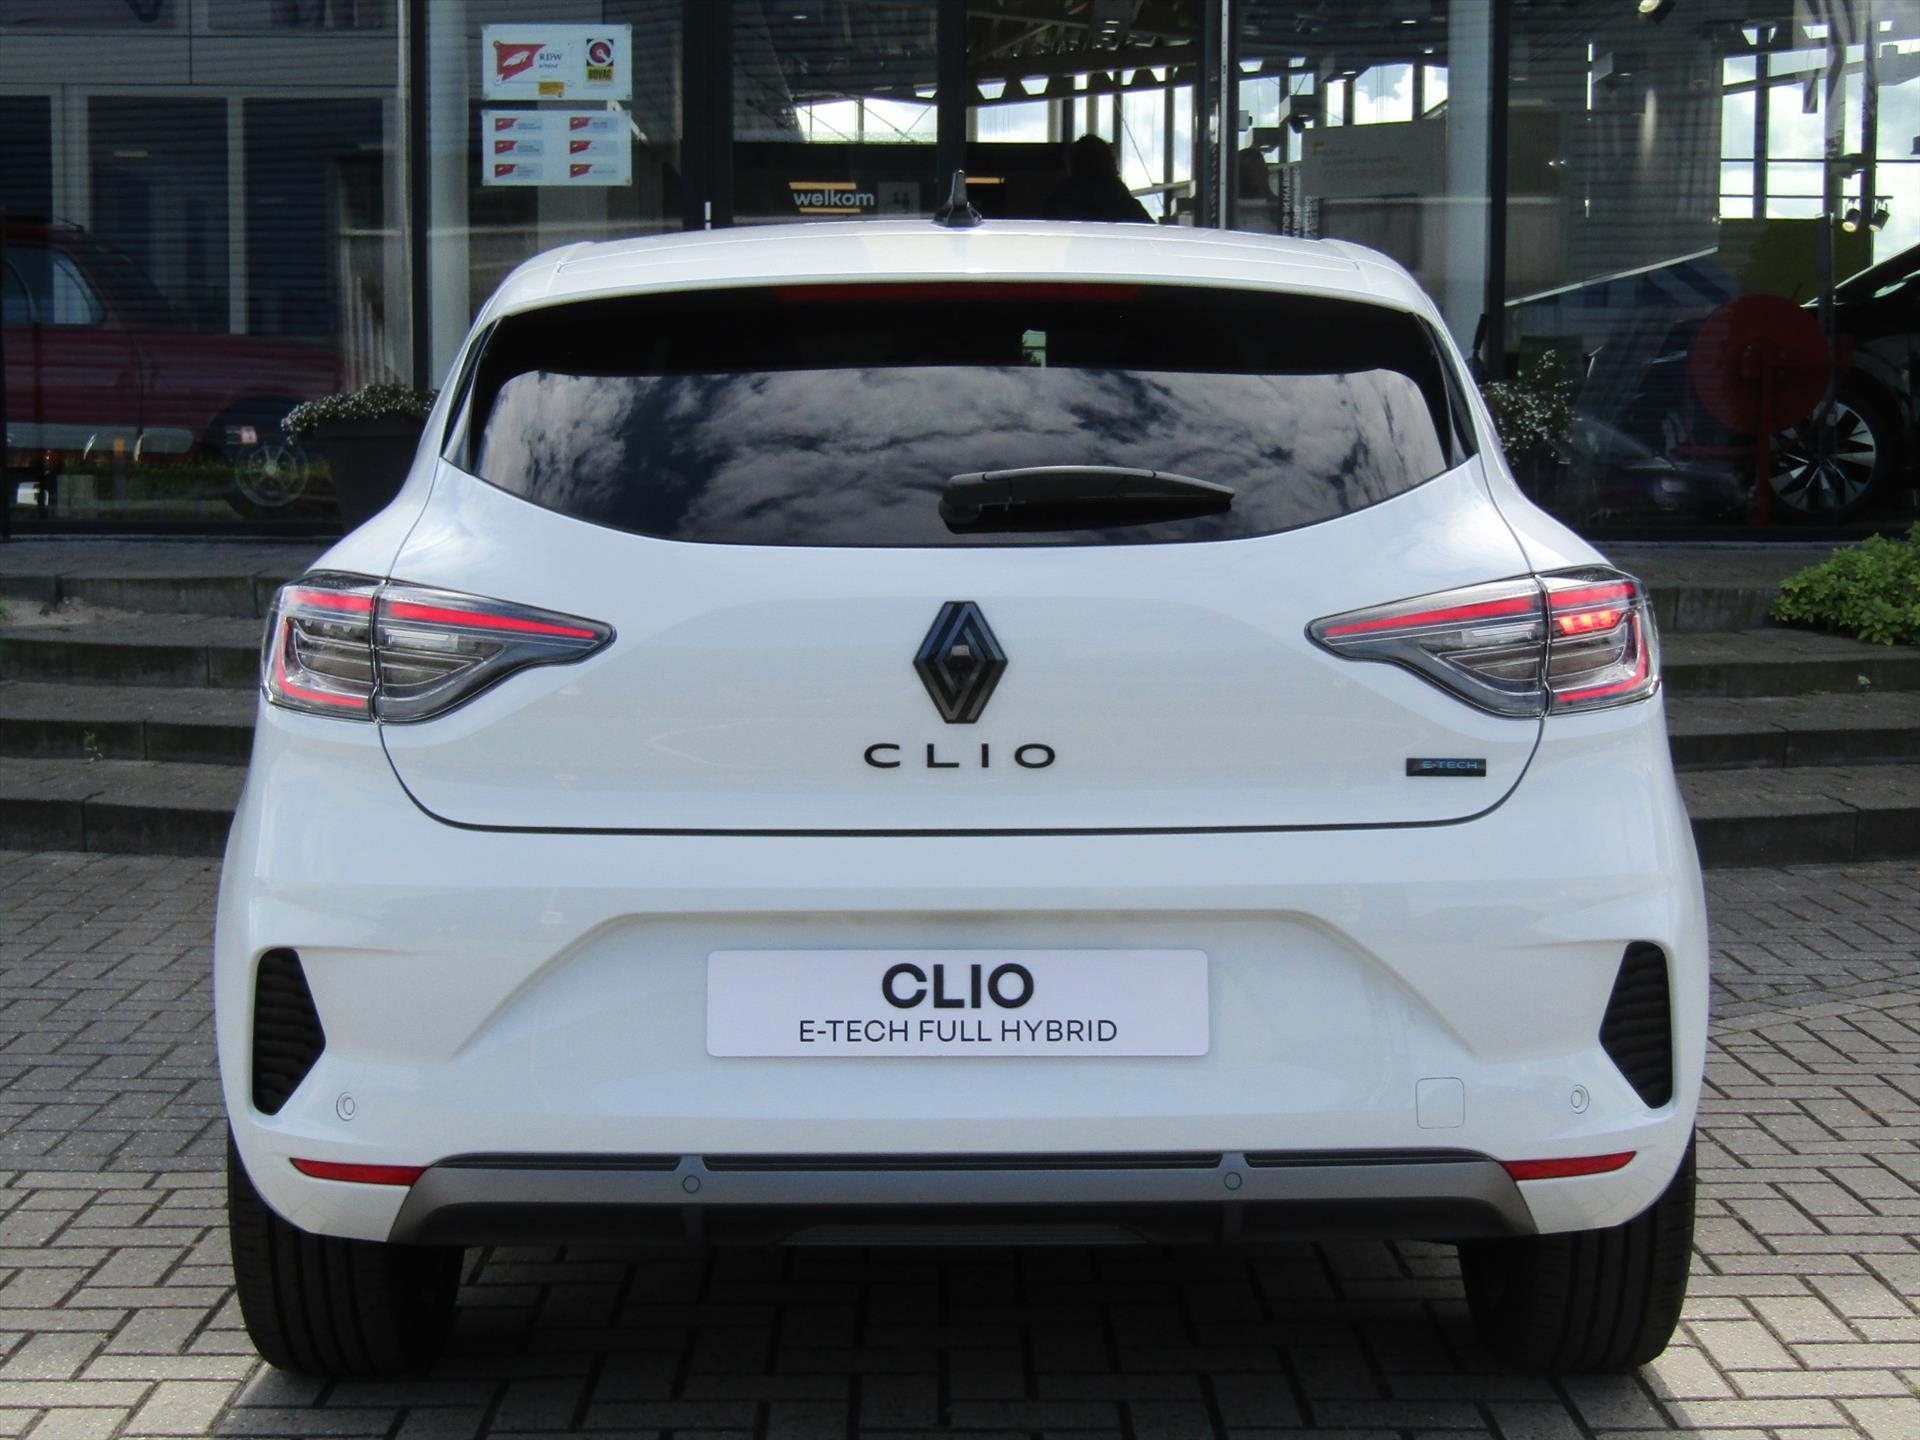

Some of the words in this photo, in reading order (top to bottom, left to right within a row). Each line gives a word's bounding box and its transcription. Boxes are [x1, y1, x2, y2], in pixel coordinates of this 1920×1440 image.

[539, 53, 562, 61] RDW
[587, 69, 612, 81] BOVAG
[793, 189, 875, 207] welkom
[864, 743, 1056, 769] CLIO
[1422, 760, 1478, 769] E-TECH
[881, 963, 1035, 1010] CLIO
[799, 1020, 909, 1043] E-TECH
[918, 1020, 992, 1043] FULL
[1001, 1020, 1118, 1043] HYBRID
